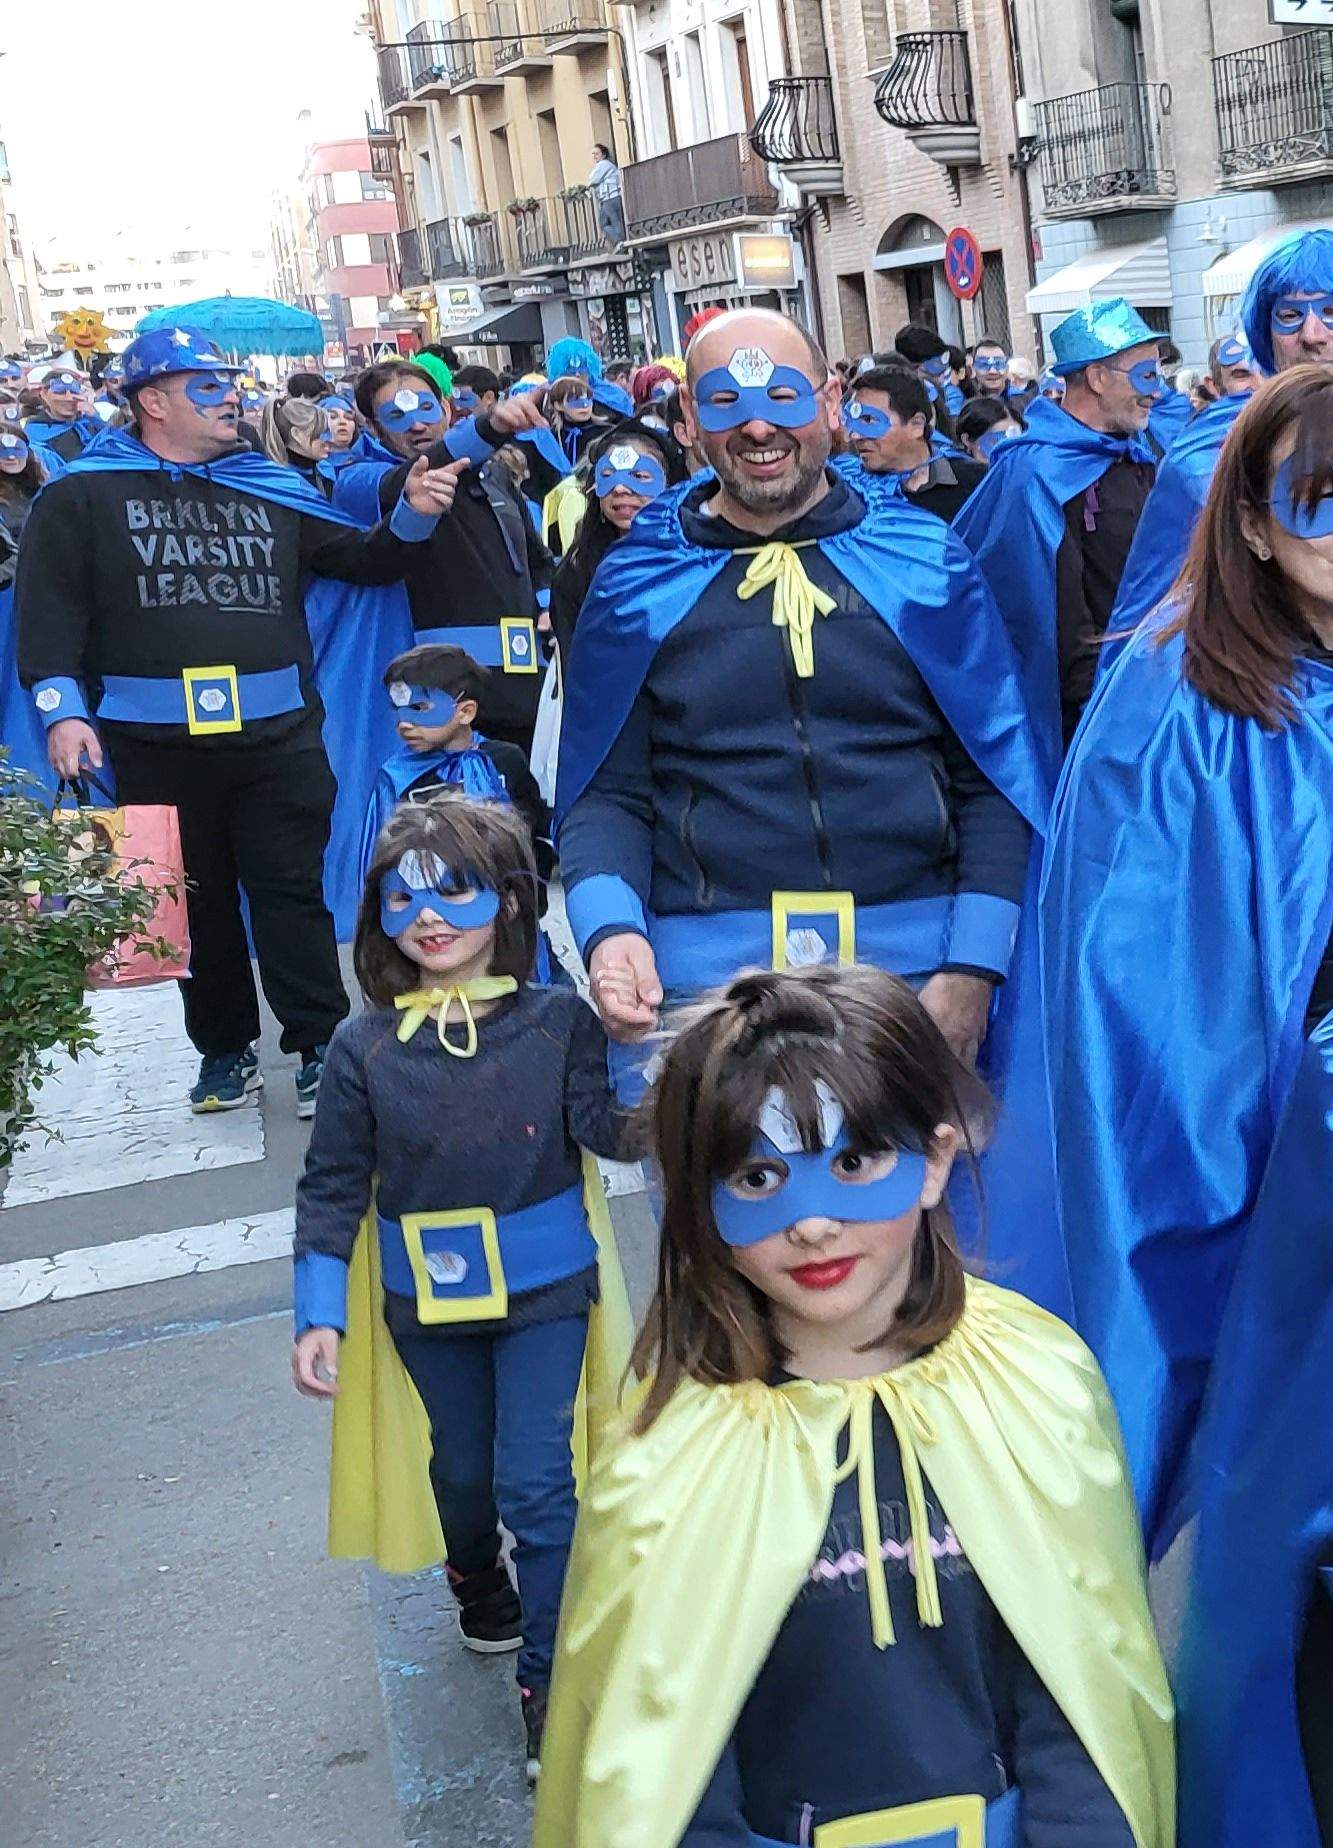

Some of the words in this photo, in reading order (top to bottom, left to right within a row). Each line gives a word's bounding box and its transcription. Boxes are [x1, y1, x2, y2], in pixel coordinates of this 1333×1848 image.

[125, 498, 272, 534] BRKLYN
[131, 534, 275, 568] VARSITY
[137, 573, 283, 608] LEAGUE
